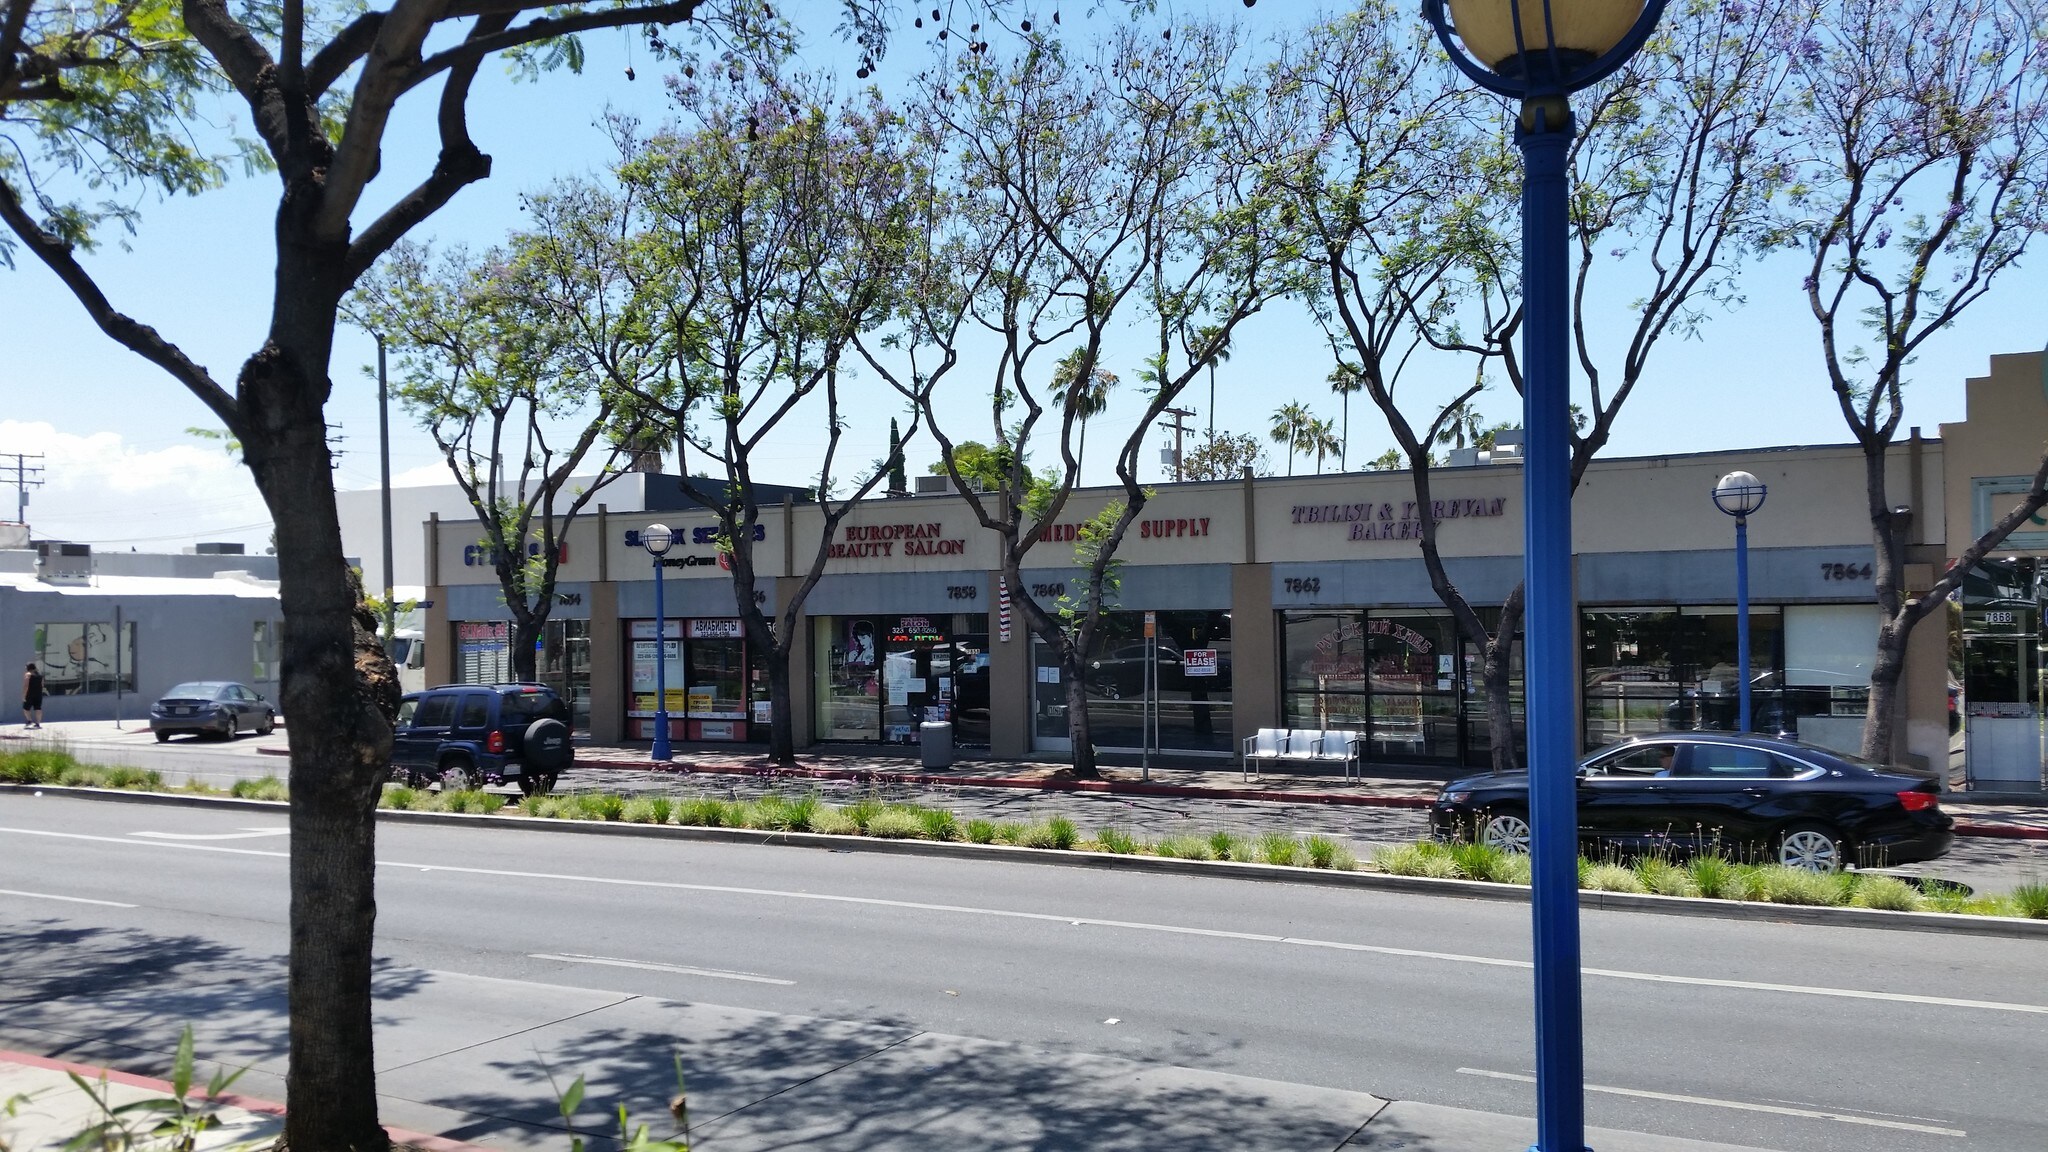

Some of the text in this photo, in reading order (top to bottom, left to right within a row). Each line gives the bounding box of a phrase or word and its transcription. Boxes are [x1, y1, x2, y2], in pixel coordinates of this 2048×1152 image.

[1291, 497, 1507, 524] TBILISI & YREVAN
[845, 523, 942, 541] EUROPEAN
[1140, 517, 1211, 539] SUPPLY
[828, 539, 966, 559] BEAUTY SALON
[1821, 562, 1873, 581] 7864
[1032, 583, 1065, 598] 7860
[1284, 577, 1321, 593] 7862
[752, 590, 766, 604] 56
[946, 586, 977, 600] 7858
[1986, 612, 2012, 622] 7868
[695, 621, 736, 632] АВИАБИЛЕТЫ
[1315, 619, 1433, 654] РУССКИЙ ХЛЕБ
[1186, 658, 1215, 666] LEASE
[1443, 658, 1451, 667] A
